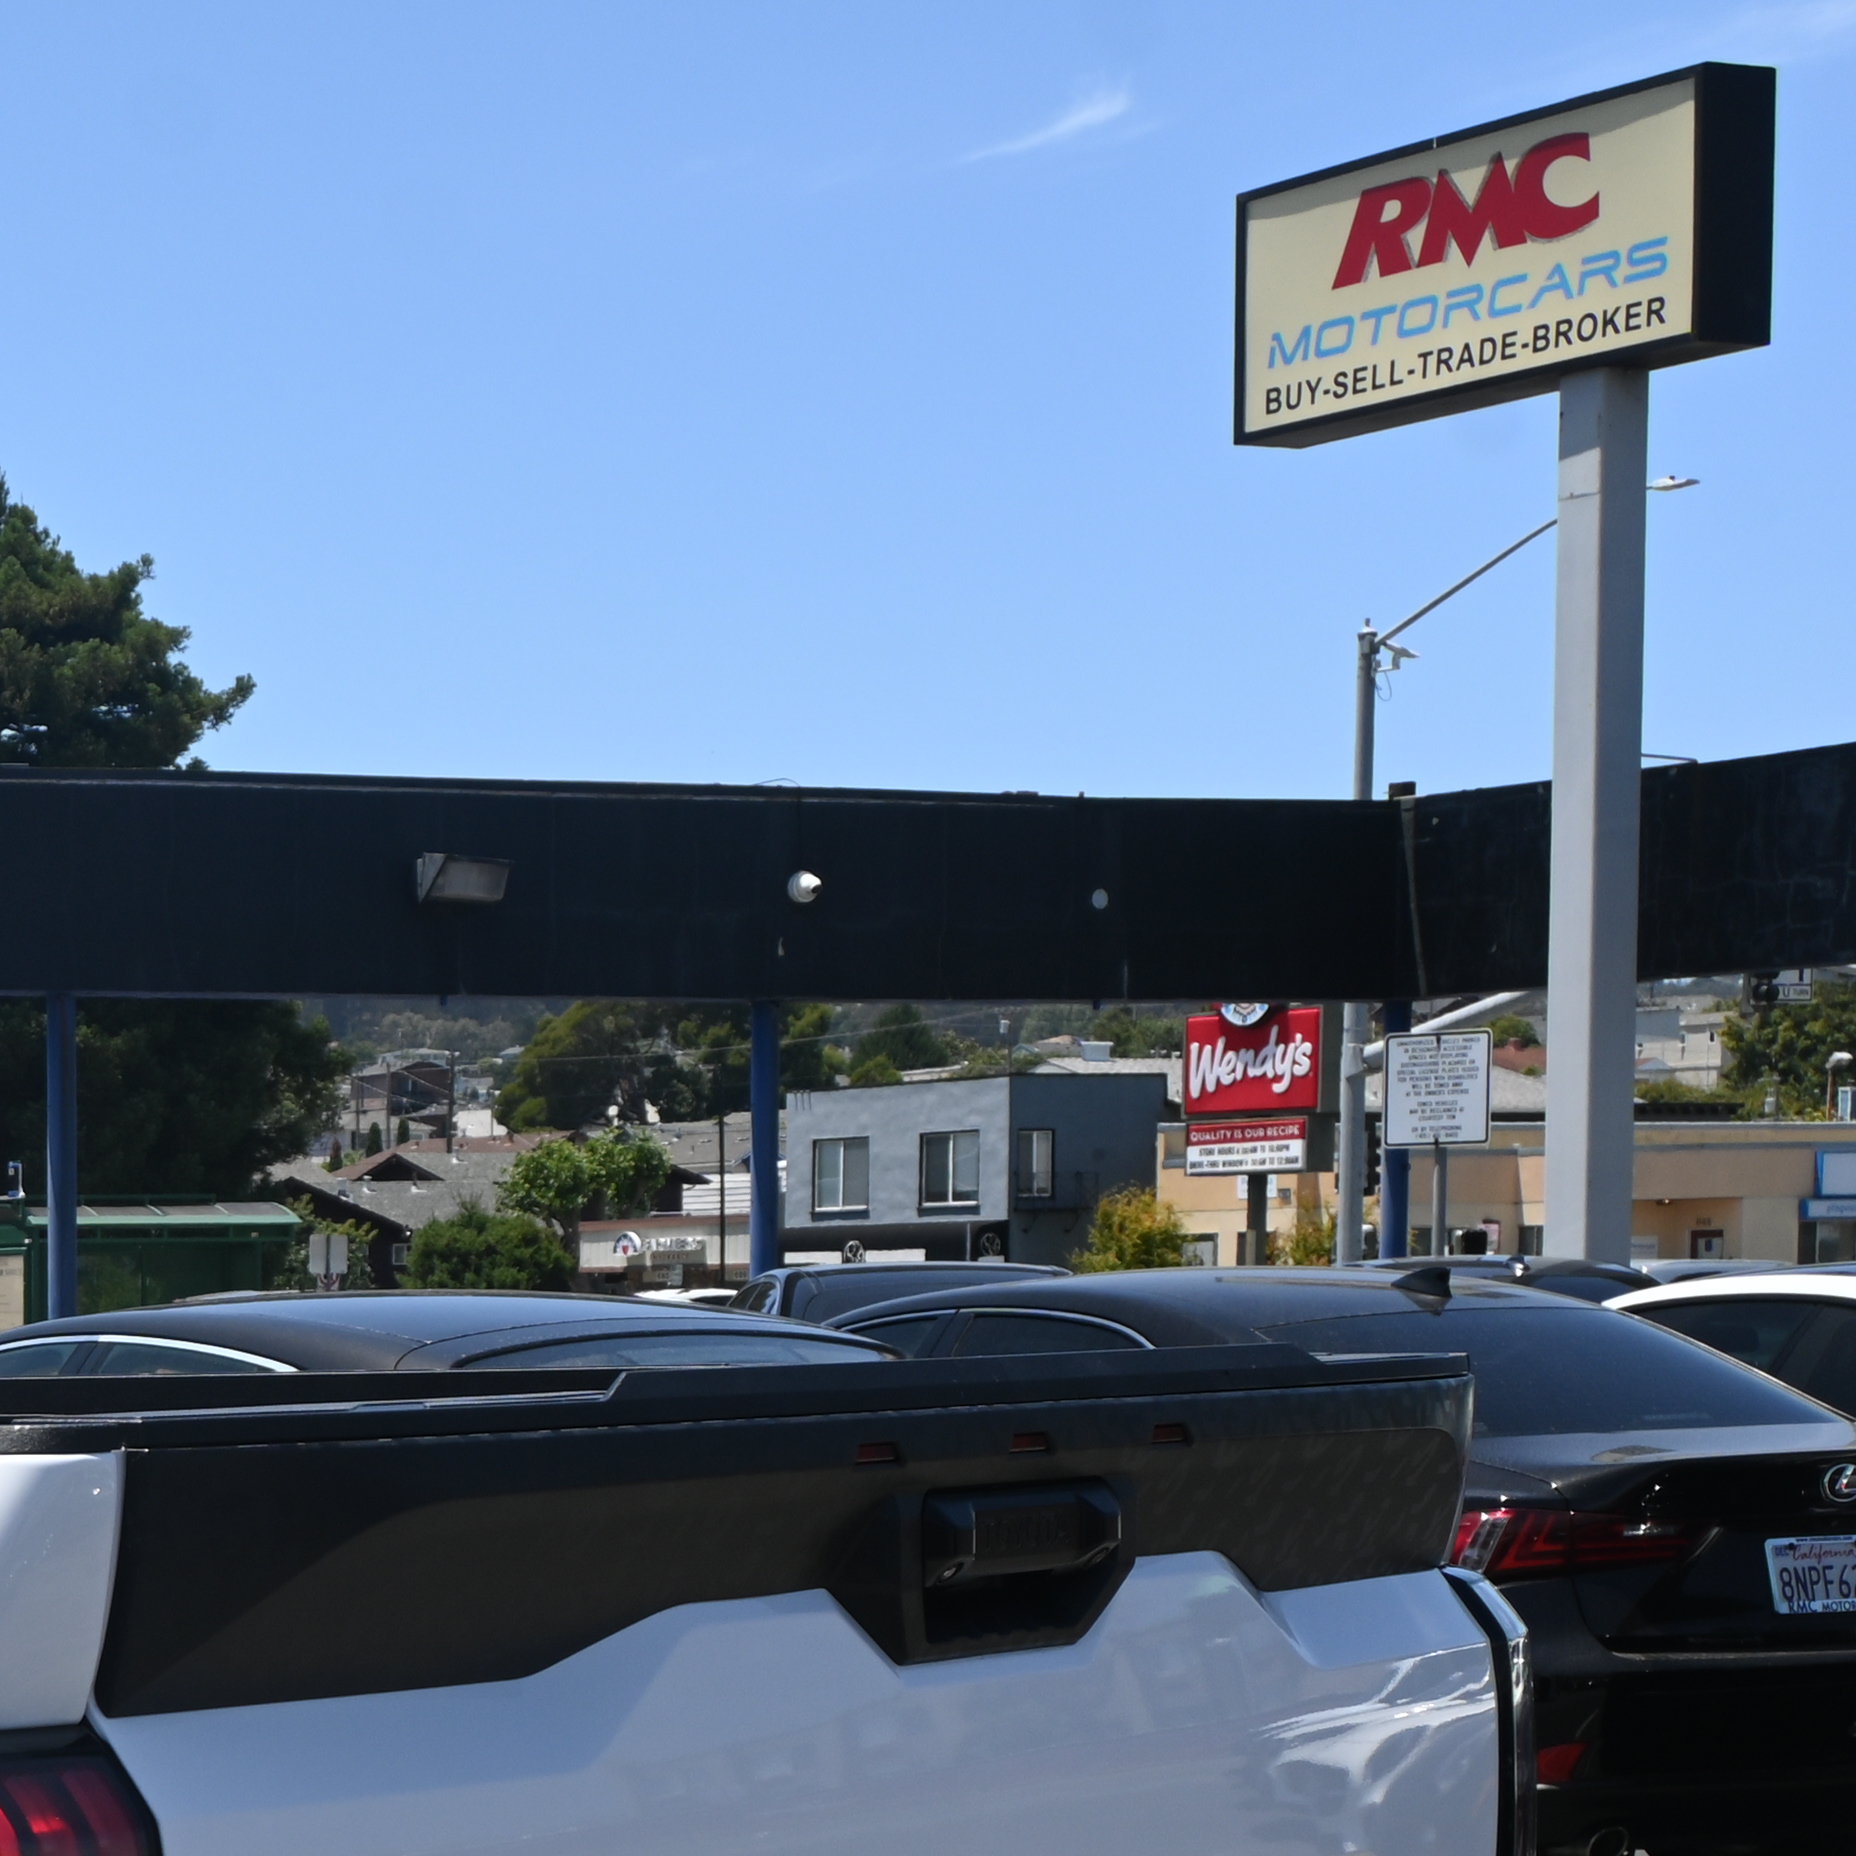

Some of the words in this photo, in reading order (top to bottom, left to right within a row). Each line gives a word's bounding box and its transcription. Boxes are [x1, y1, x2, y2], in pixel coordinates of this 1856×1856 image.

[1331, 131, 1600, 291] RMC
[1264, 295, 1668, 415] BUY-SELL-TRADE-BROKER
[1267, 235, 1669, 369] MOTORCARS
[1189, 1025, 1313, 1100] Wendy's
[1190, 1130, 1232, 1141] QUALITY
[1234, 1129, 1243, 1139] IS
[1245, 1127, 1265, 1138] OUR
[1266, 1125, 1300, 1137] RECIPE
